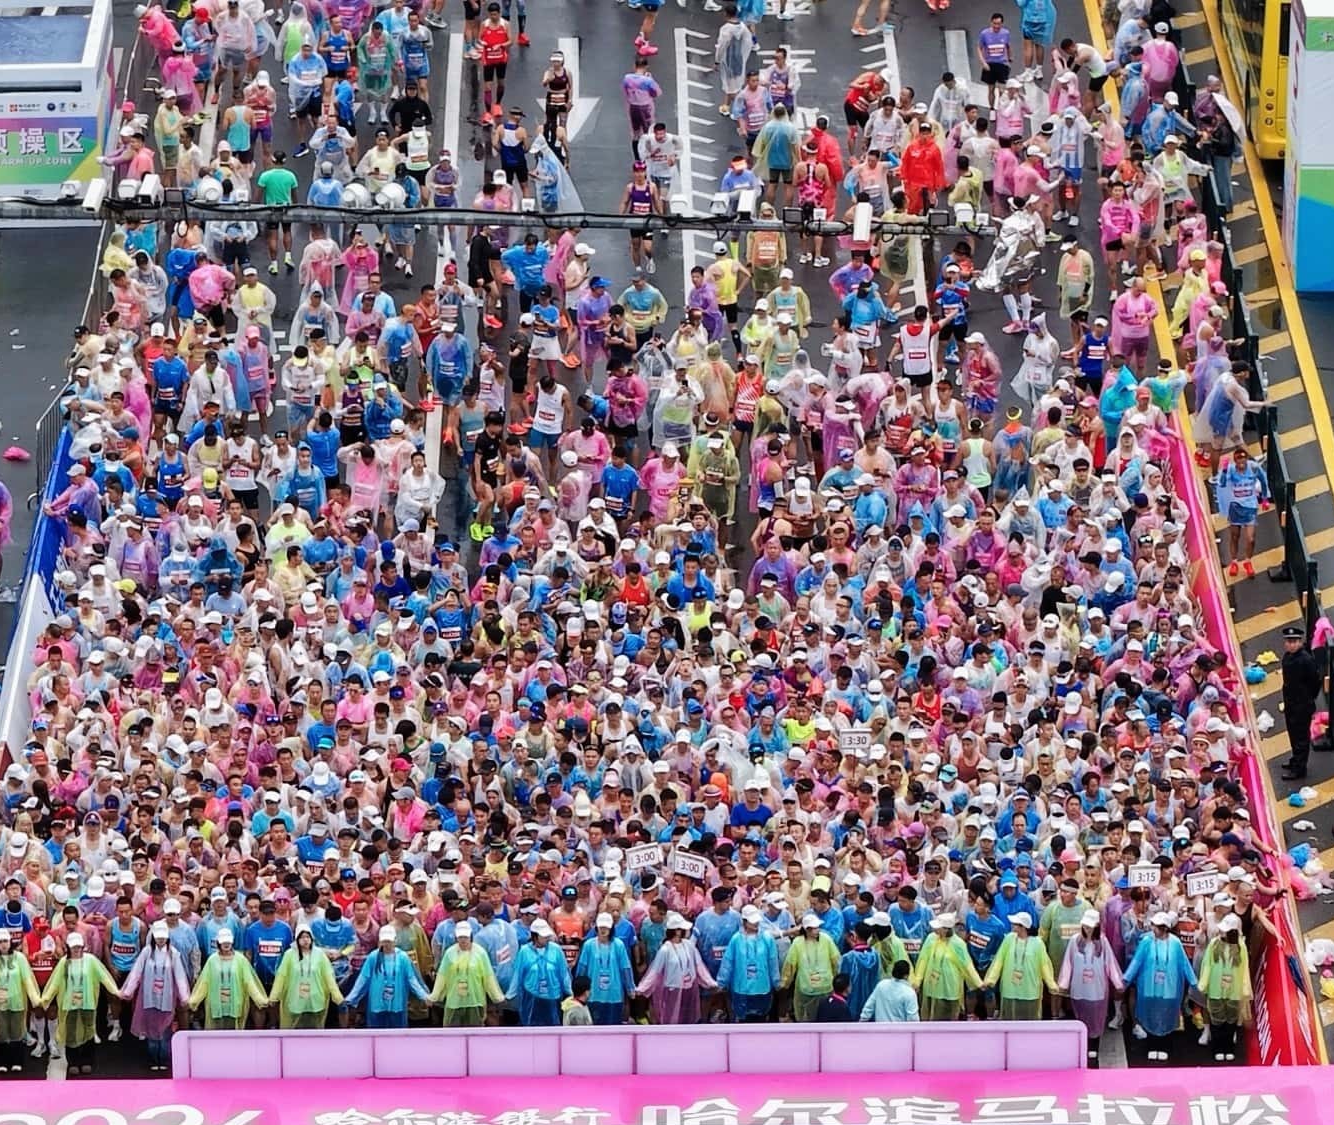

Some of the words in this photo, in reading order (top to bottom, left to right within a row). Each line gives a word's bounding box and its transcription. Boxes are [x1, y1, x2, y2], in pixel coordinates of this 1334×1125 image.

[847, 735, 867, 745] 3:30
[635, 851, 655, 863] 3:00
[680, 858, 700, 873] 3:00
[1138, 871, 1156, 882] 3:15
[1196, 877, 1215, 890] 3:15
